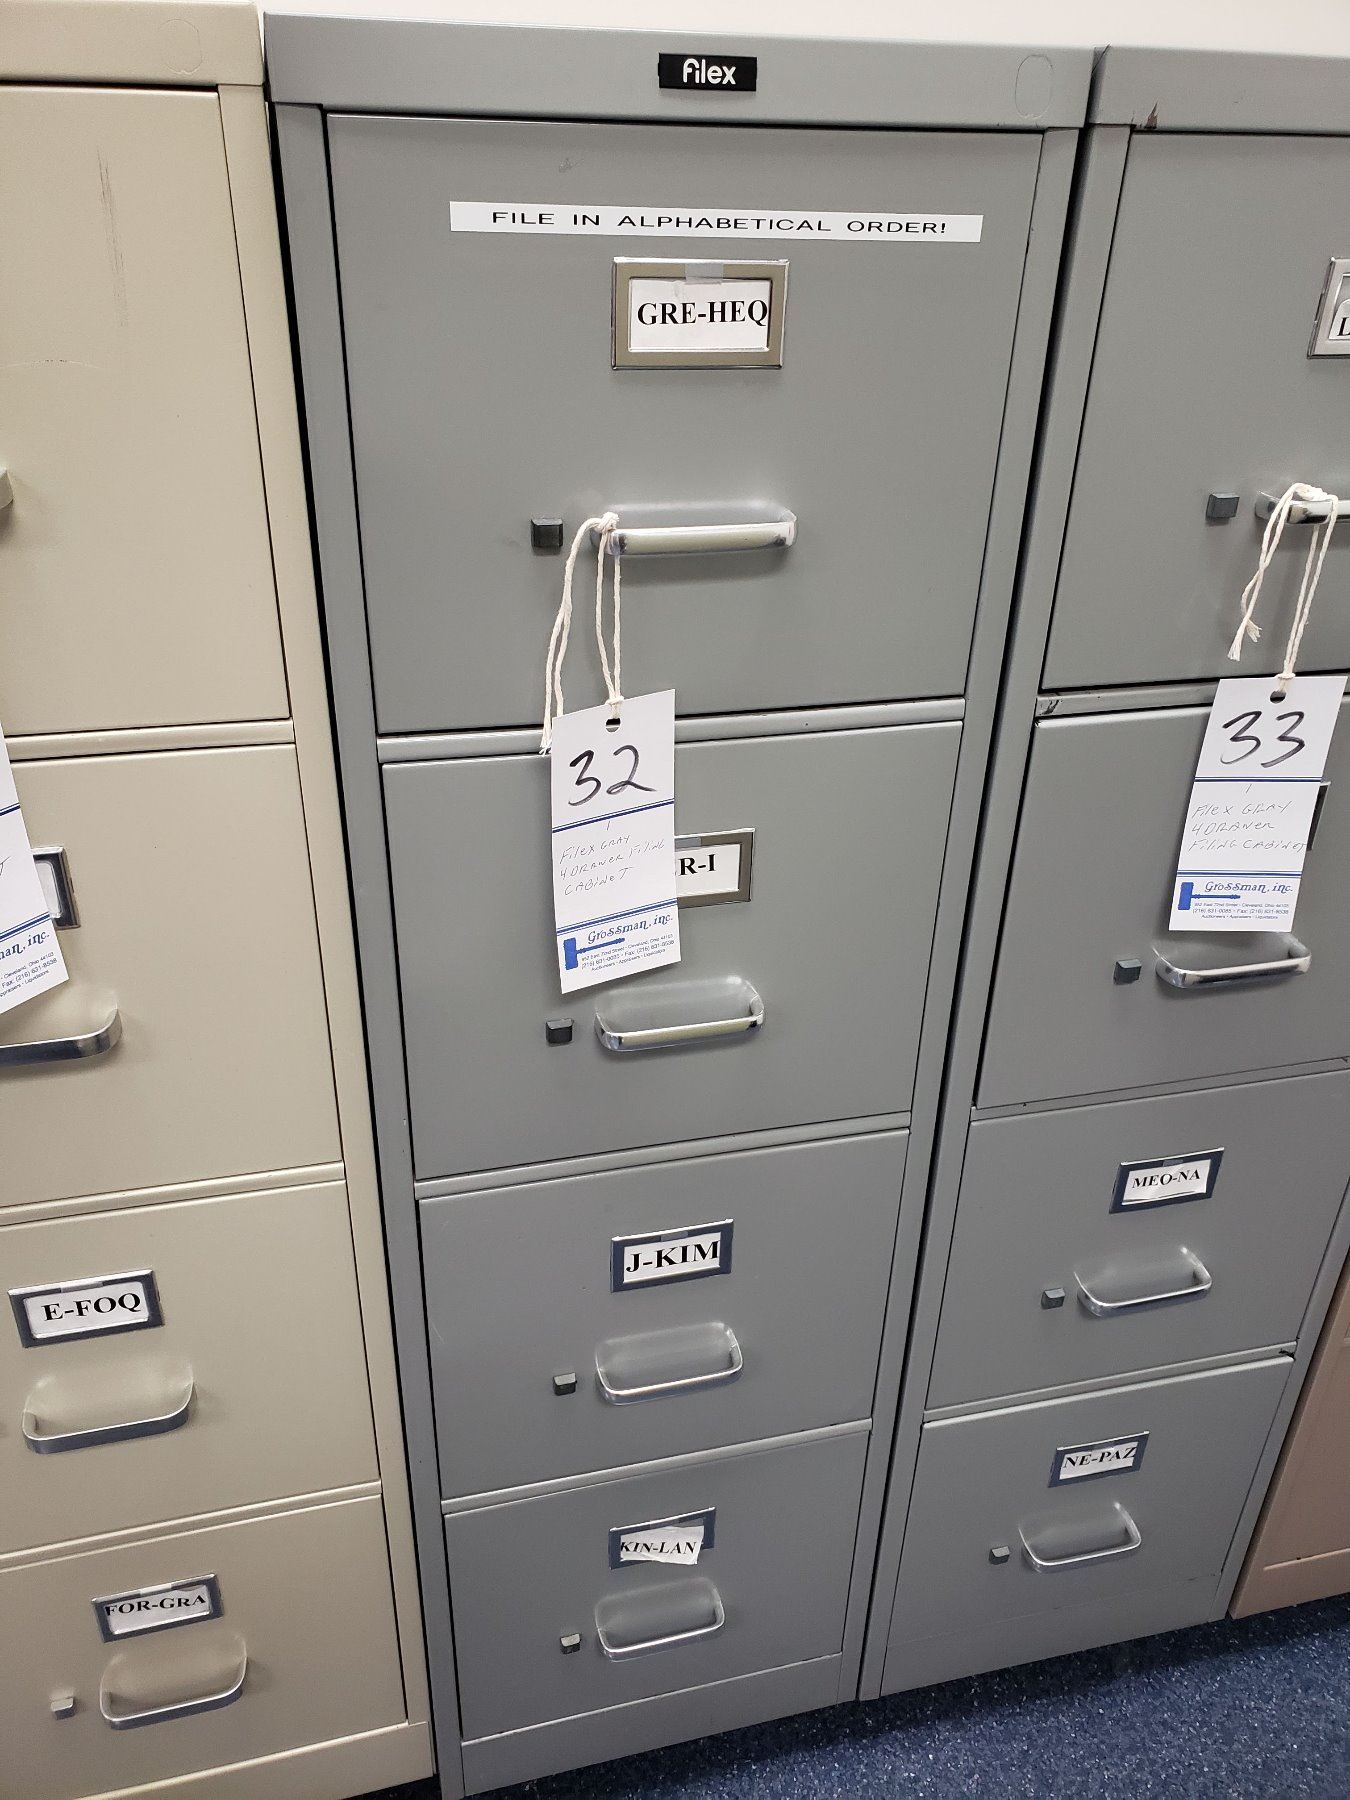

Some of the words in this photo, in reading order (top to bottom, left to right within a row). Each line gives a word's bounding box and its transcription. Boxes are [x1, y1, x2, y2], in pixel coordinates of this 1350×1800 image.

[492, 211, 555, 225] FILE
[573, 213, 600, 226] IN
[617, 215, 832, 232] ALPHABETICAL
[847, 220, 946, 234] ORDER!
[637, 299, 768, 327] GRE-HEQ
[1220, 710, 1305, 768] 33
[568, 744, 657, 806] 32
[675, 853, 716, 876] R-I
[27, 931, 50, 947] inc.
[1131, 1168, 1200, 1188] MEO-NA
[625, 1240, 720, 1273] J-KIM
[41, 1292, 141, 1321] E-FOQ
[1063, 1446, 1137, 1468] NE-PAZ
[620, 1541, 697, 1554] KIN-LAN
[104, 1594, 206, 1616] FOR-GRA
